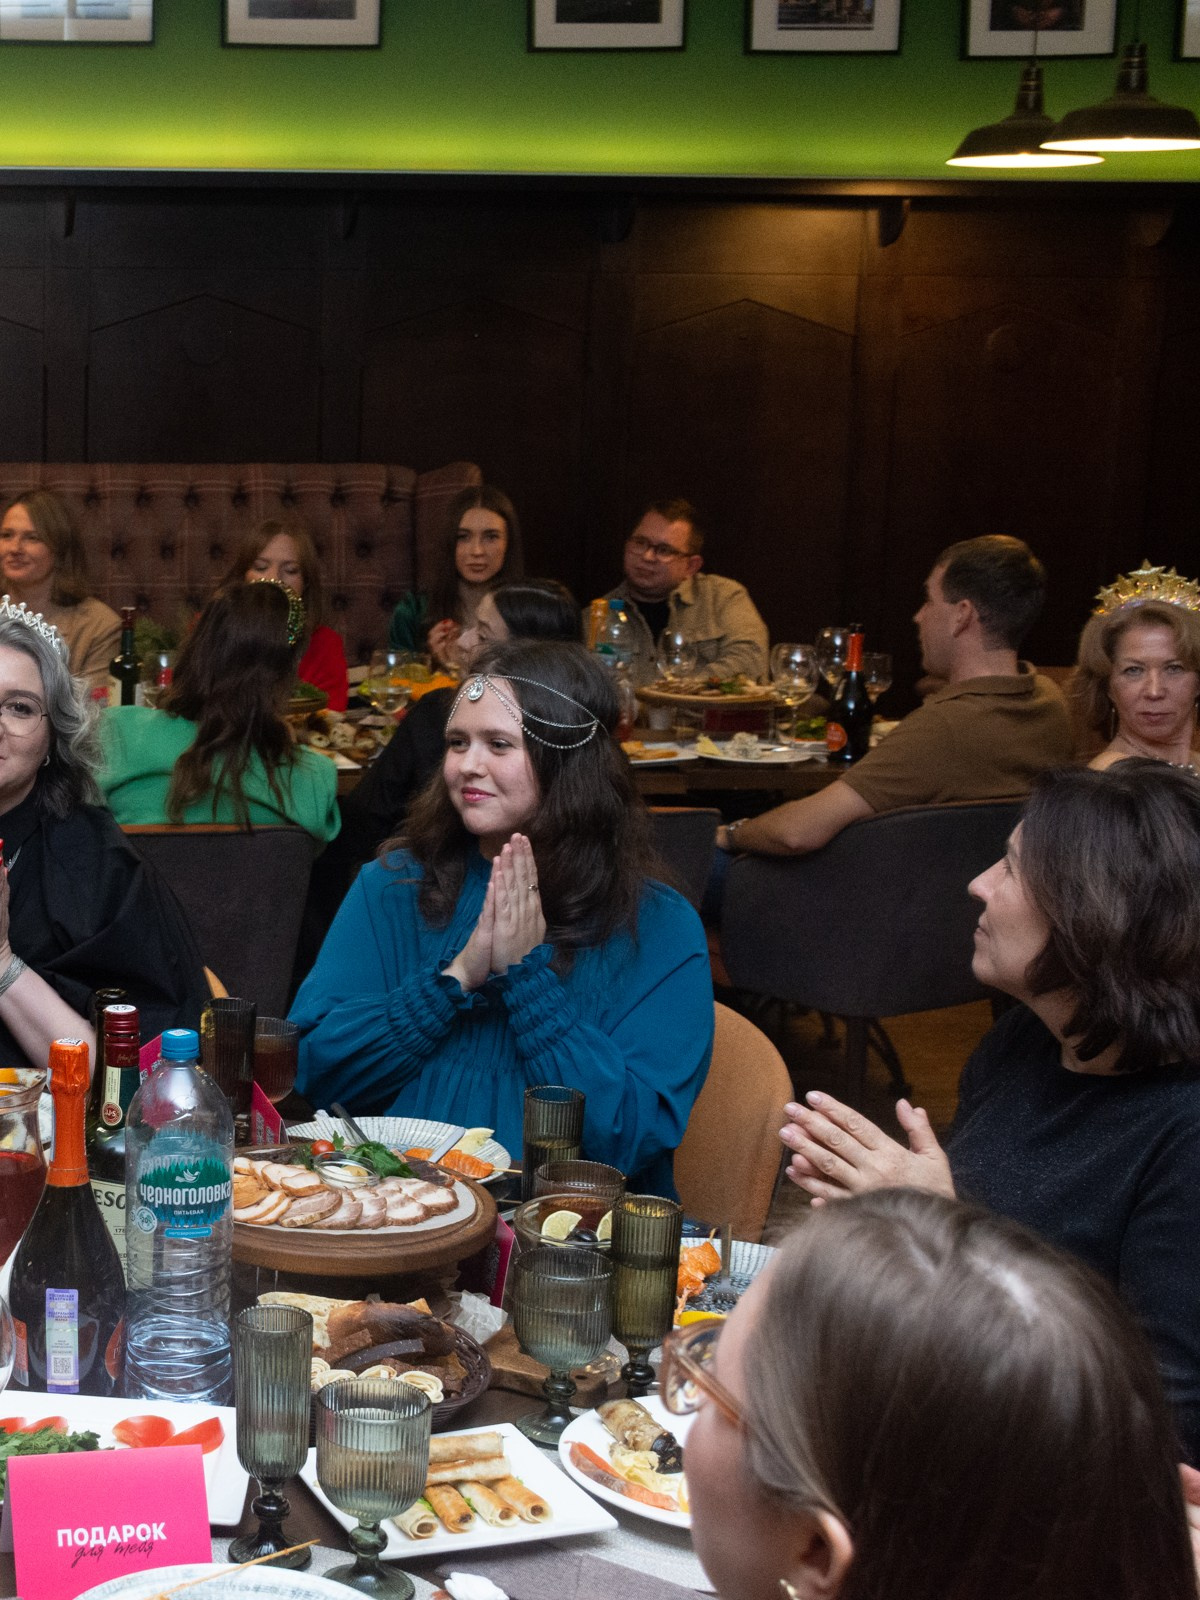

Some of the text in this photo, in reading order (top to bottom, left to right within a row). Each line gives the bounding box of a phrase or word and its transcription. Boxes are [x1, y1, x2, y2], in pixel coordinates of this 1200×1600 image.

[56, 1521, 167, 1548] ПОДАРОК
[71, 1532, 154, 1568] для тебя
